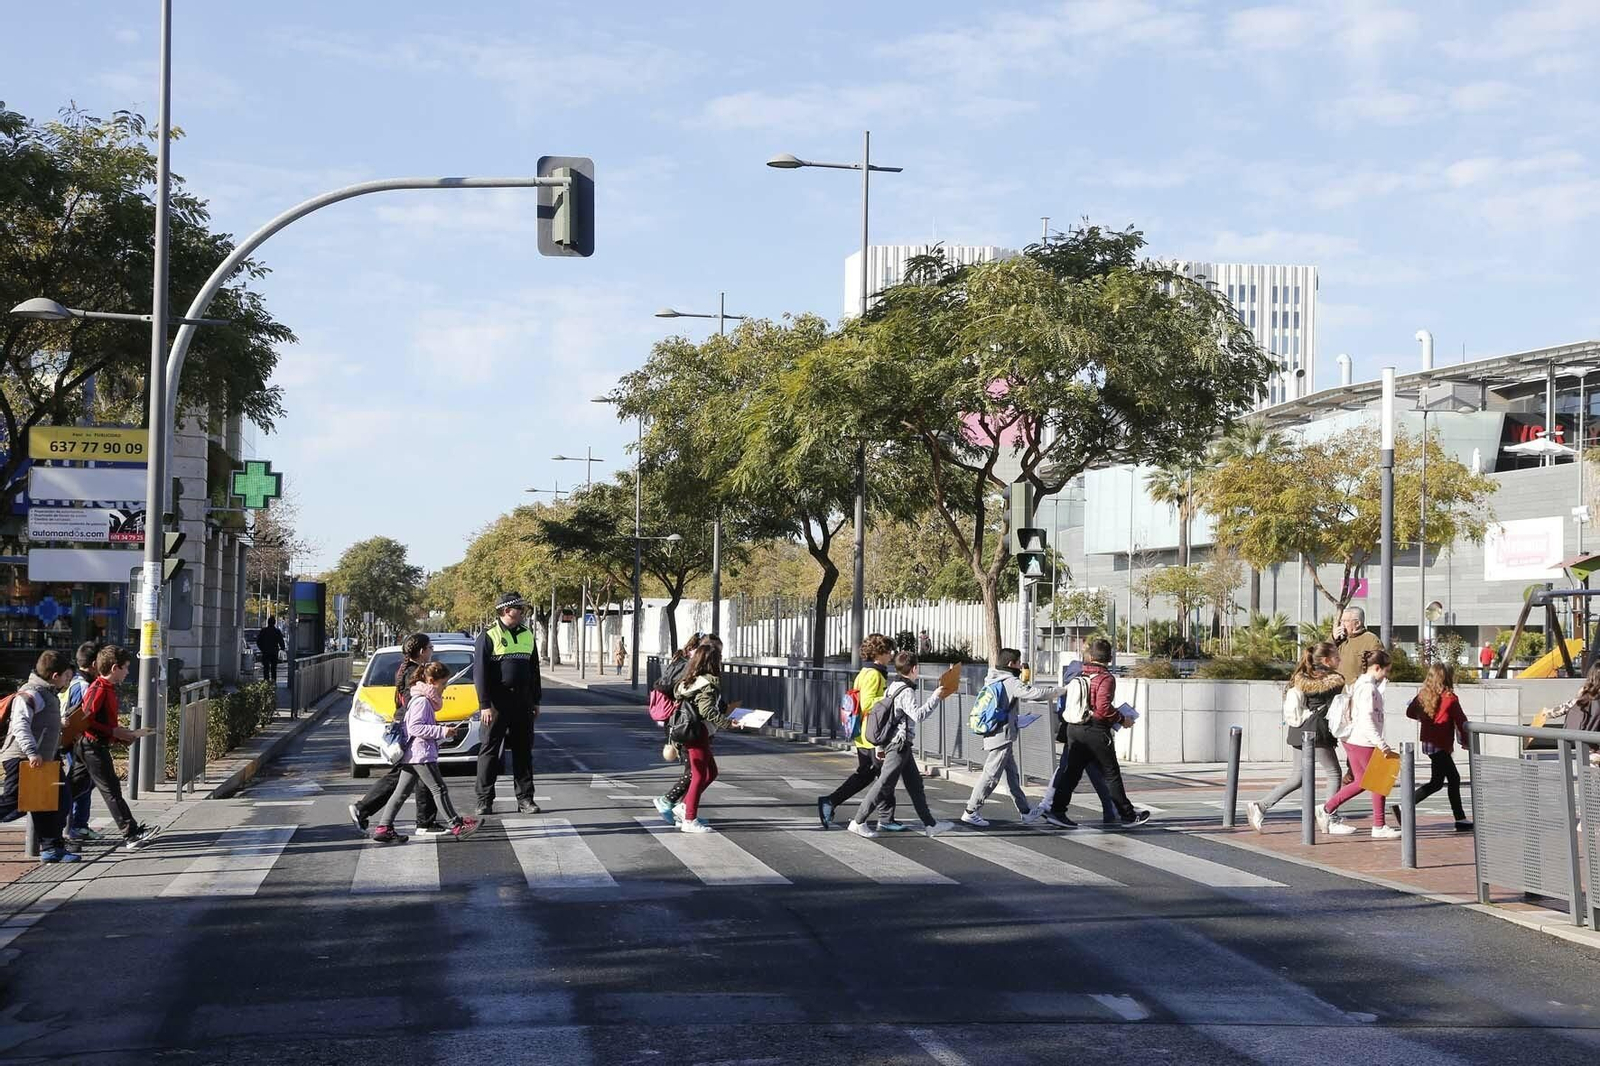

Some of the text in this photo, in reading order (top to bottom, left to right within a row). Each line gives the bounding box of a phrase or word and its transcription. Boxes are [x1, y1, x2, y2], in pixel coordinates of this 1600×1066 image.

[50, 441, 142, 454] 637 77 90 09
